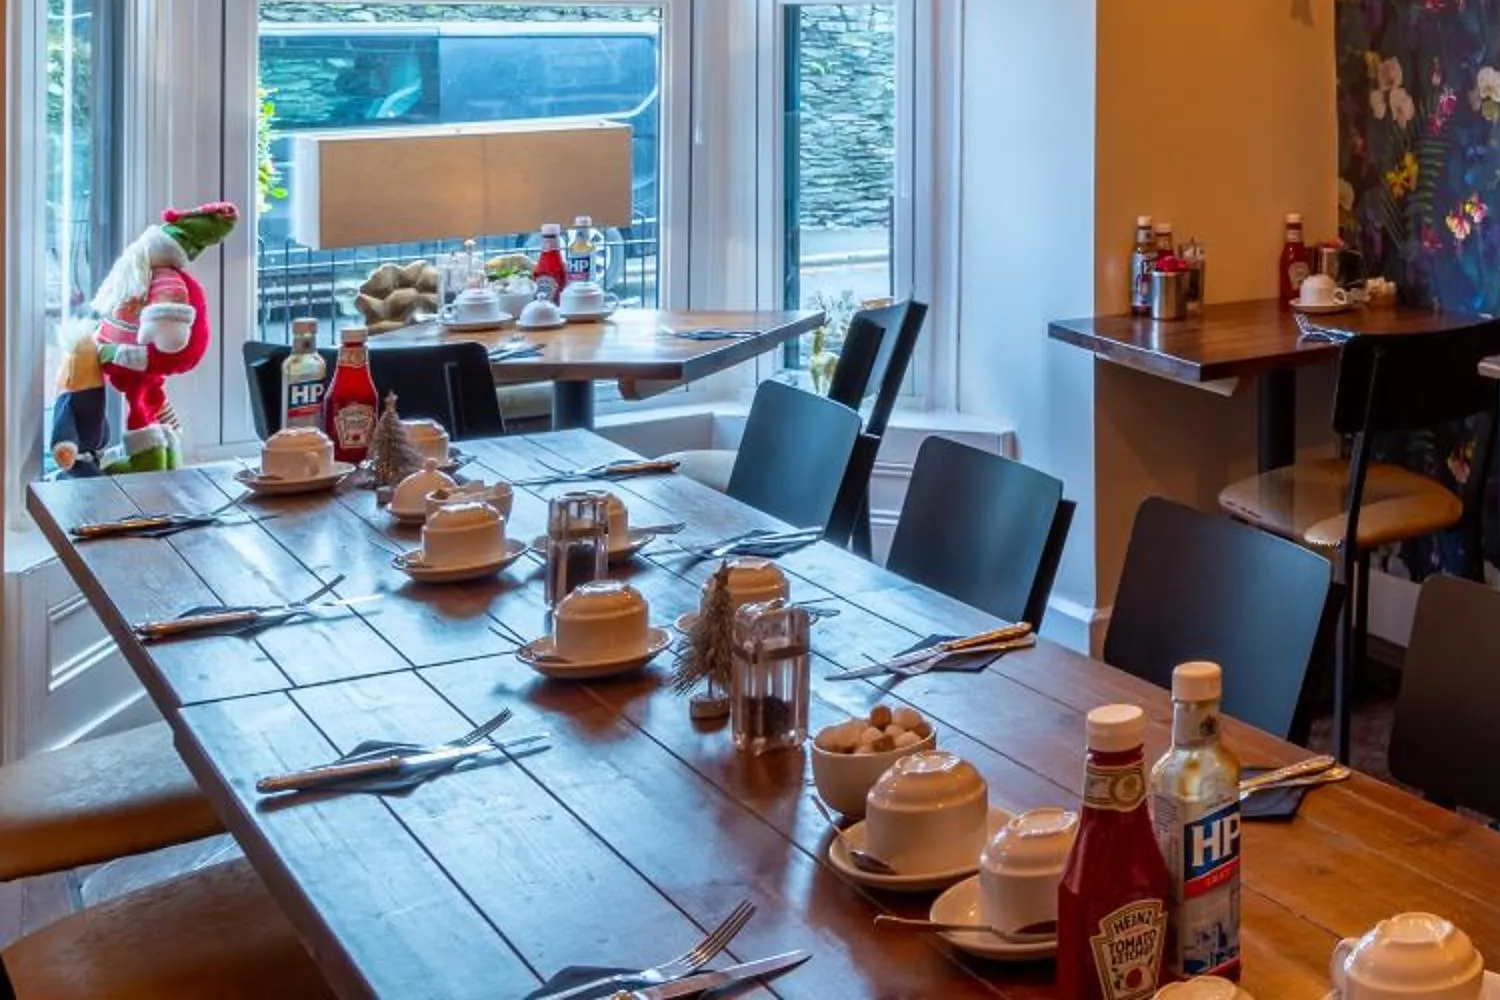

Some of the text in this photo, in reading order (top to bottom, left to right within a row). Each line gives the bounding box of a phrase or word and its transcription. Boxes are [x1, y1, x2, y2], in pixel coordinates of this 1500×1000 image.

[569, 259, 589, 273] HP
[291, 384, 324, 404] HP
[1191, 812, 1240, 868] HP
[1113, 909, 1153, 934] HEINZ
[1107, 928, 1157, 955] TOMATO
